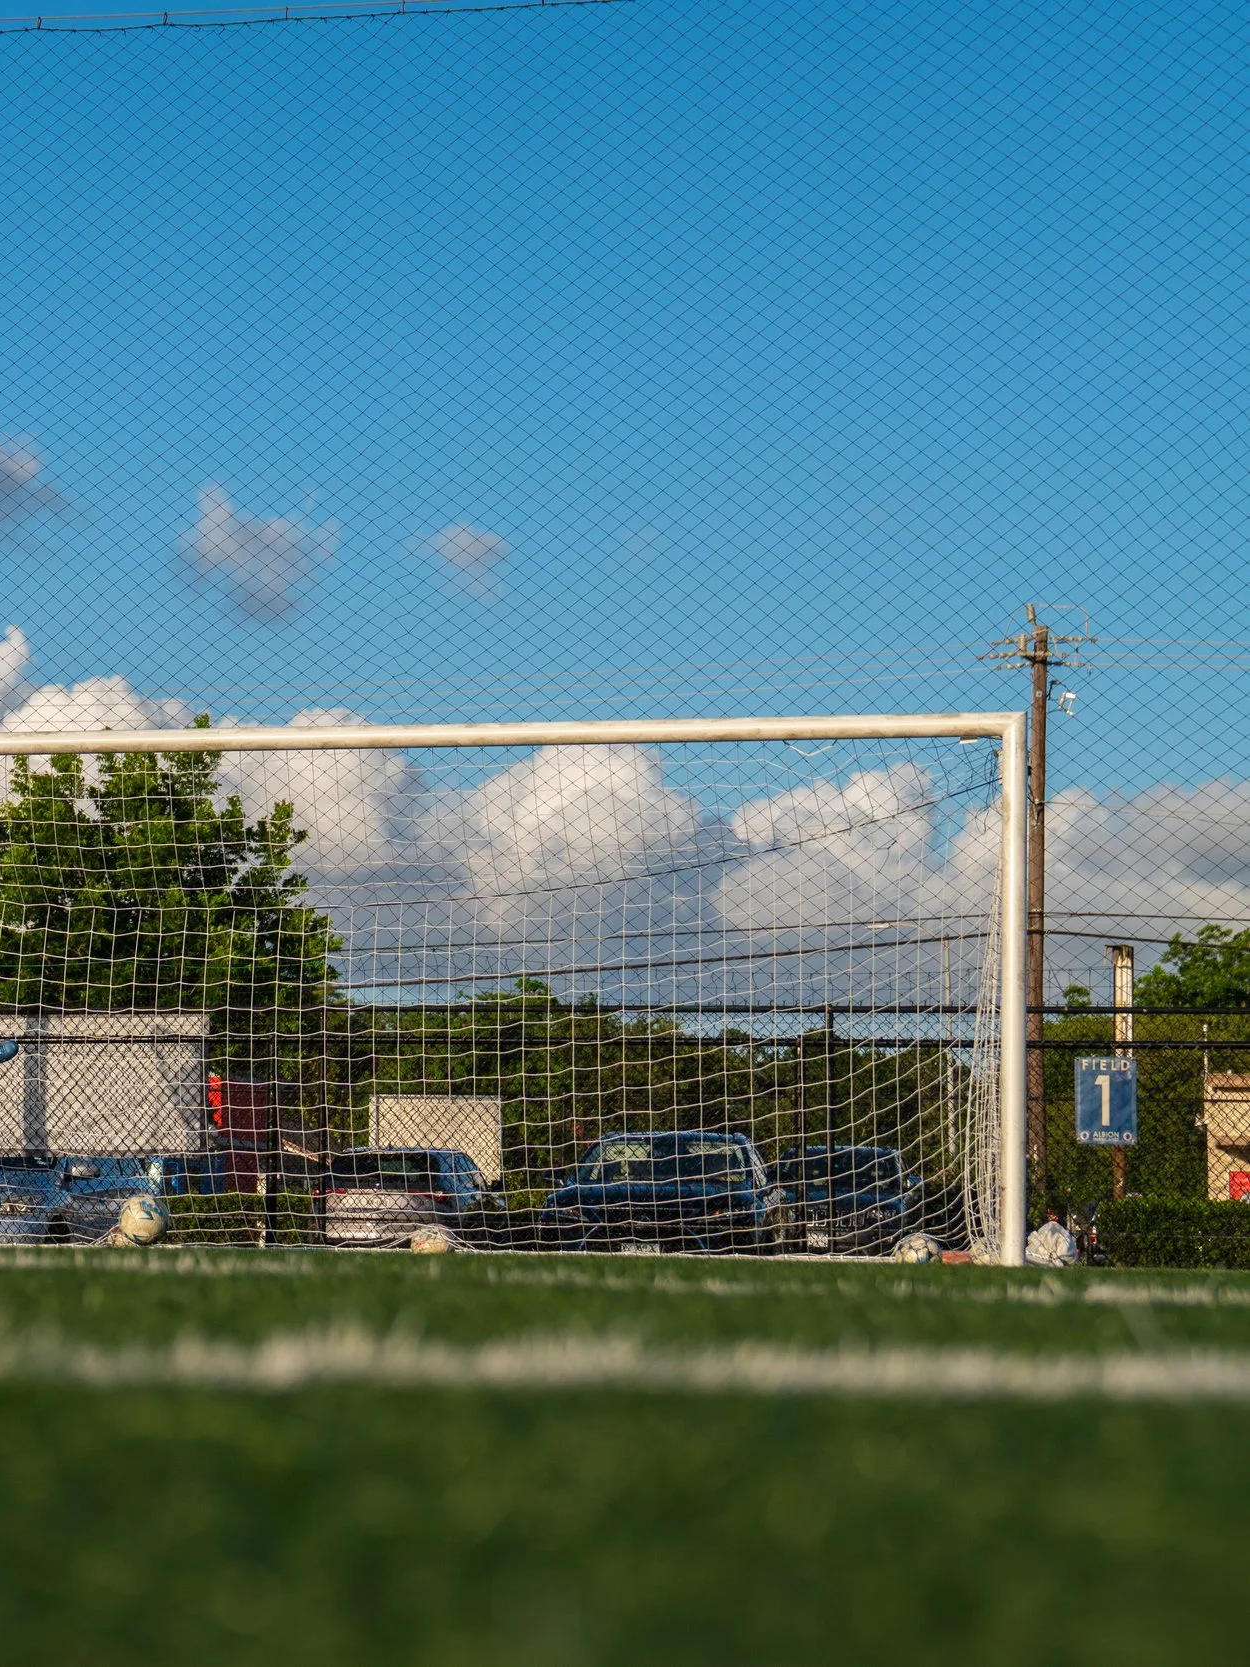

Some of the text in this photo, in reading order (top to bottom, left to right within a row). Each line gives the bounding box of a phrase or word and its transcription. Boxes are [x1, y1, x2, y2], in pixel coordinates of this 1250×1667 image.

[1081, 1058, 1131, 1071] FIELD
[1094, 1074, 1111, 1127] 1
[1092, 1130, 1120, 1138] ALBION
